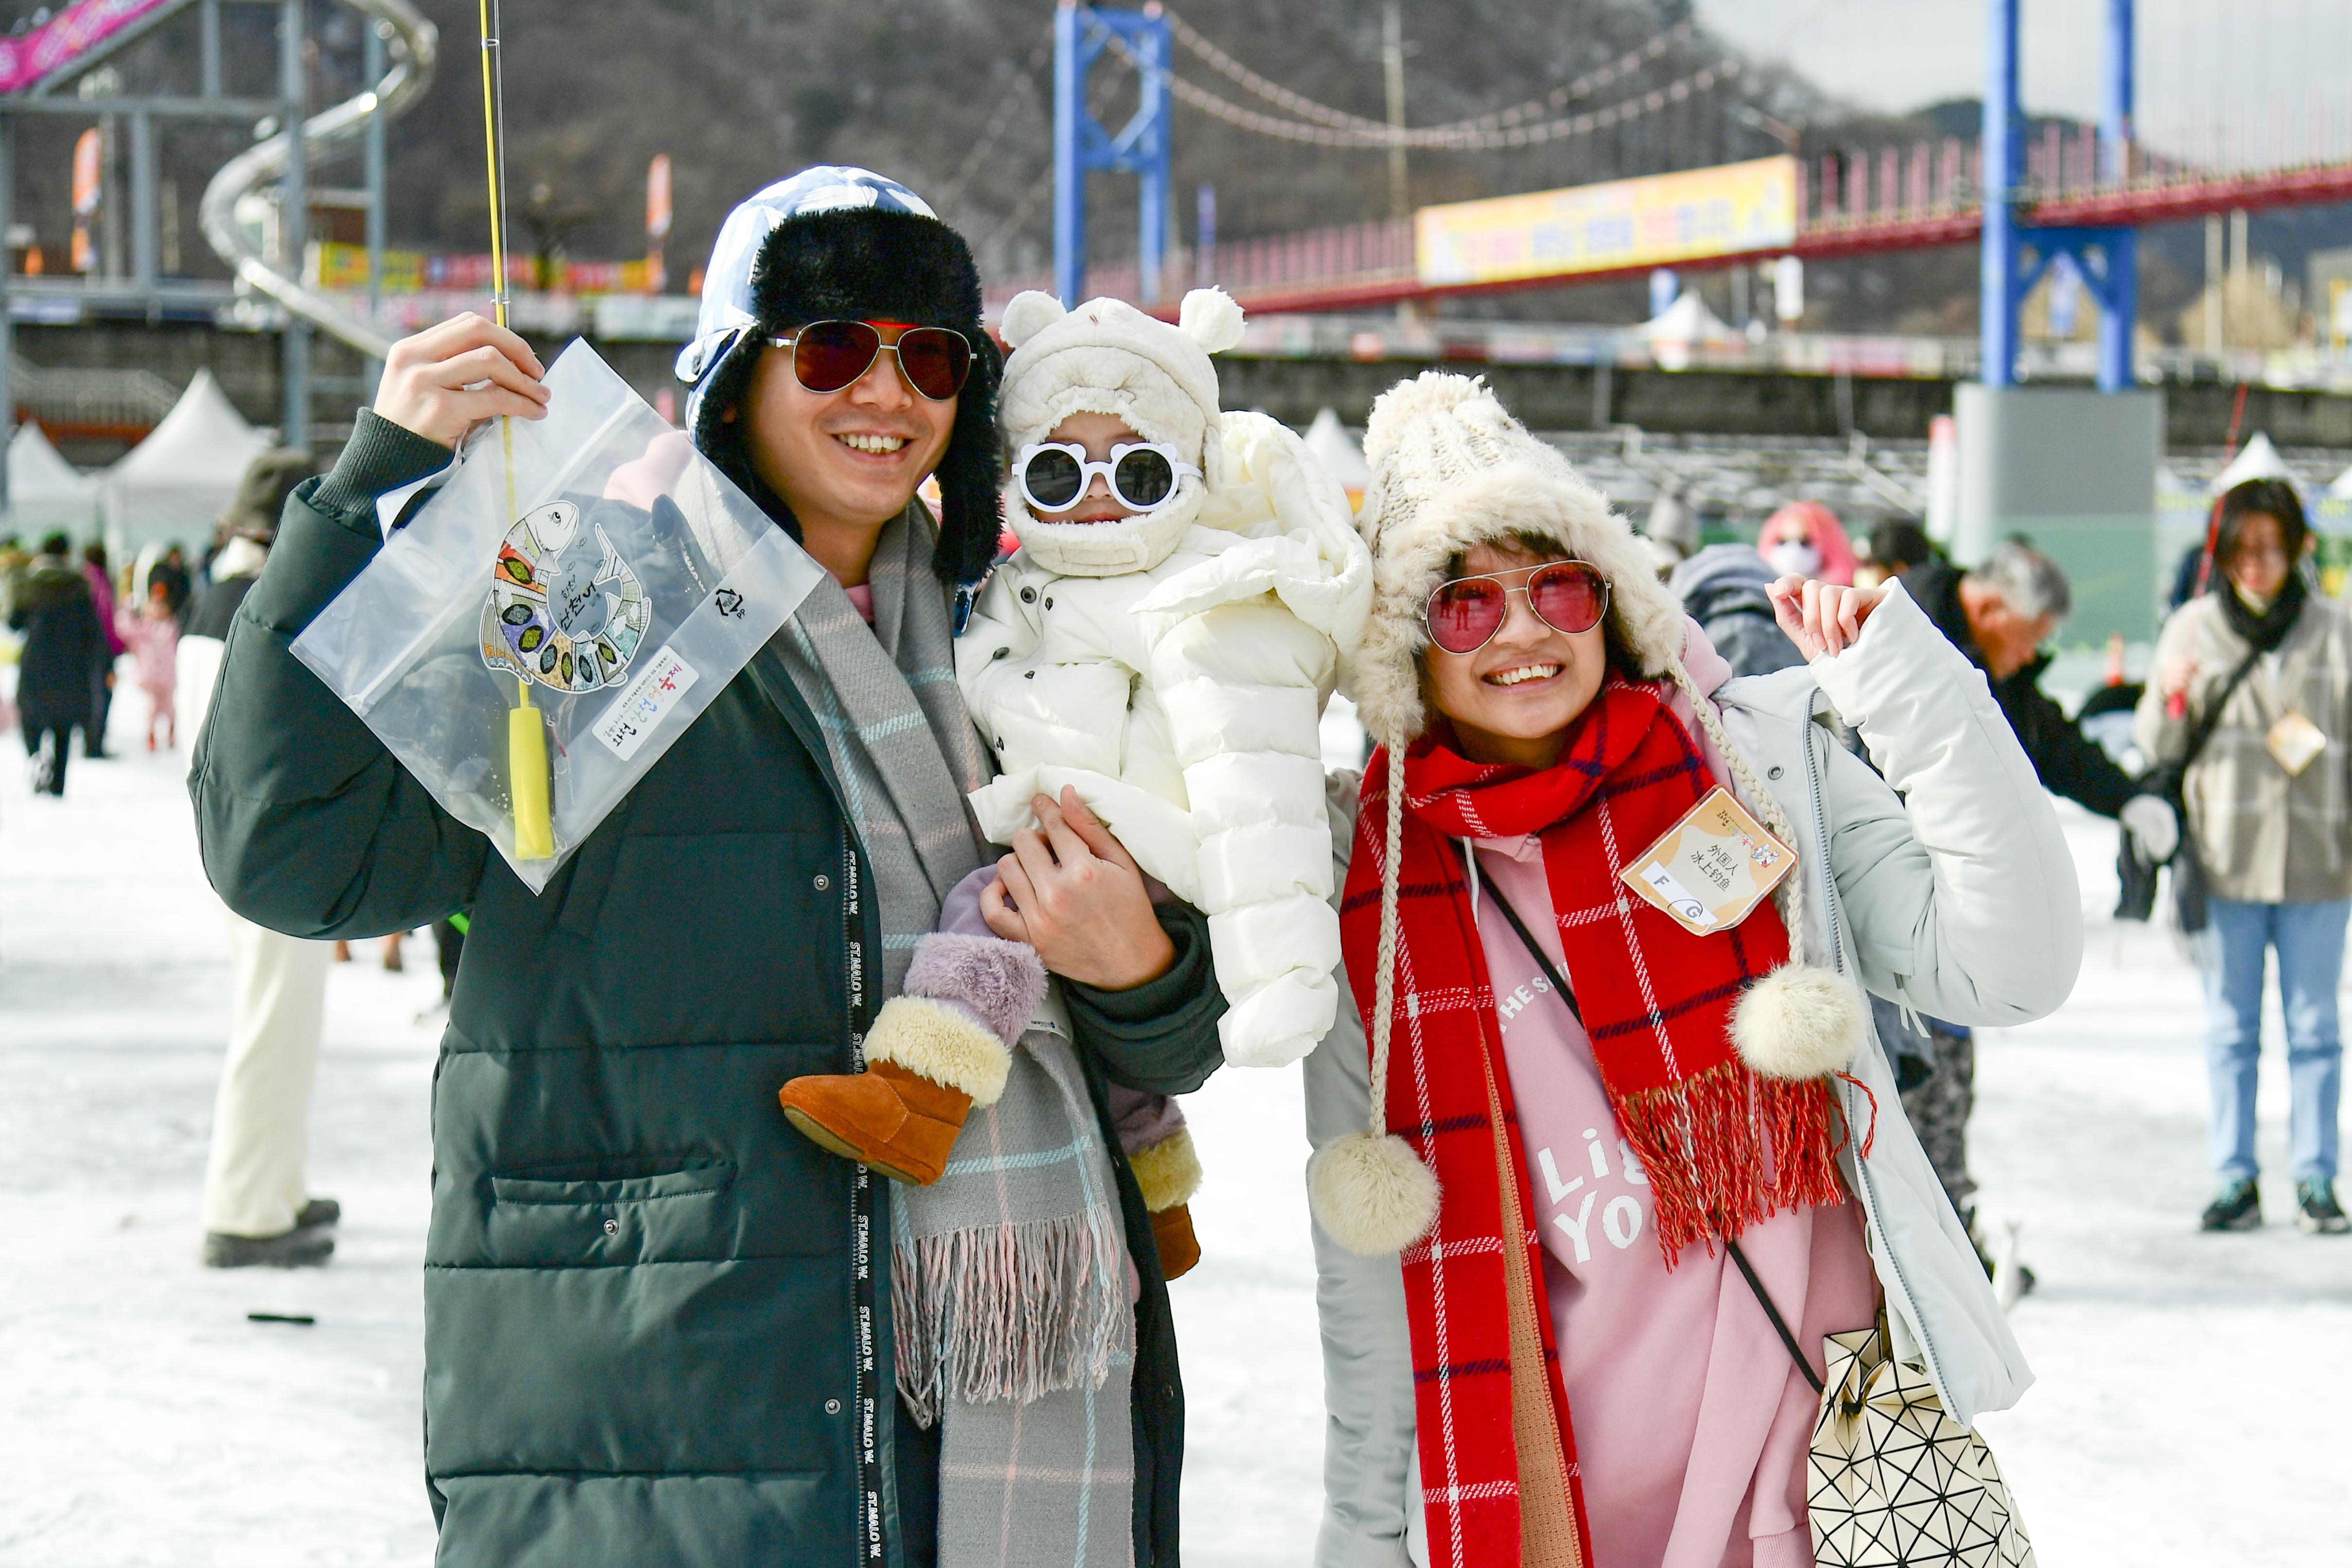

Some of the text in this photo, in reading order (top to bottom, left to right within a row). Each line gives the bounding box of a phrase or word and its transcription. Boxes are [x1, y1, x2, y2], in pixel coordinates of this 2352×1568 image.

[560, 581, 596, 631] 산천어
[561, 574, 577, 601] 화천
[737, 608, 745, 620] PP
[612, 723, 637, 747] 화천
[1690, 850, 1731, 892] 冰上钓鱼
[1707, 844, 1739, 876] 外国人
[848, 900, 858, 915] W.
[1653, 875, 1701, 918] F G
[850, 941, 862, 1007] ST.MALO W.
[852, 1033, 863, 1075] ST.MAL
[857, 1175, 868, 1189] W.
[857, 1215, 869, 1280] ST.MALO W.
[1552, 1189, 1643, 1264] YO
[859, 1306, 873, 1372] ST.MALO W.
[863, 1397, 874, 1465] ST.MALO W.
[867, 1490, 881, 1559] ST.MALO W.
